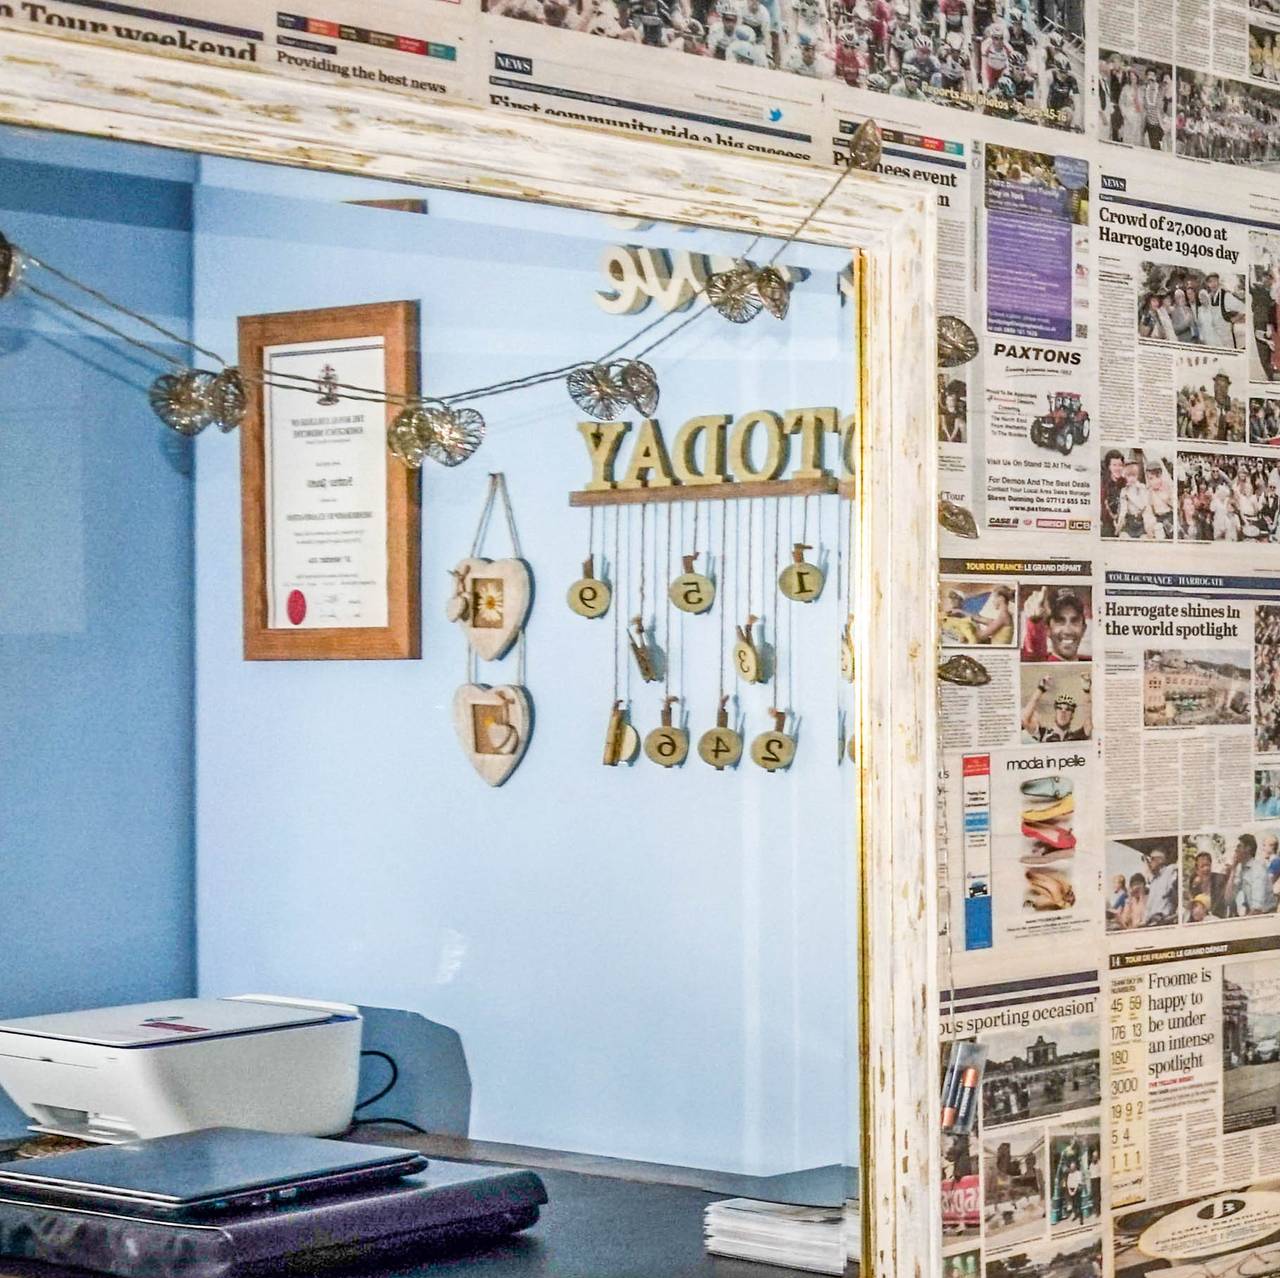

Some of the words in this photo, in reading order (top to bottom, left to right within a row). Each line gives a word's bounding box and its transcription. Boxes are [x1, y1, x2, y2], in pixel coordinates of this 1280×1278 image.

[277, 50, 350, 78] Providing
[352, 66, 375, 81] the
[378, 69, 408, 88] best
[410, 79, 447, 94] news
[496, 56, 531, 72] NEWS
[912, 169, 958, 188] event
[1101, 177, 1126, 190] NEWS
[1099, 207, 1147, 229] Crowd
[1150, 216, 1165, 231] of
[1167, 221, 1212, 239] 27,000
[1214, 227, 1228, 242] at
[1099, 226, 1173, 251] Harrogate
[1175, 241, 1214, 258] 1940s
[1216, 244, 1240, 264] day
[994, 343, 1081, 365] PAXTONS
[1178, 576, 1224, 587] HARROGATE
[1105, 602, 1179, 620] Harrogate
[1181, 602, 1224, 618] shines
[1227, 605, 1240, 619] in
[1105, 621, 1129, 636] the
[1132, 621, 1173, 637] world
[1176, 622, 1238, 639] spotlight
[1007, 757, 1044, 770] moda
[1046, 755, 1056, 768] in
[1058, 754, 1086, 771] pelle
[1149, 973, 1198, 990] Froome
[1201, 967, 1212, 983] is
[1149, 994, 1187, 1013] happy
[1191, 992, 1203, 1005] to
[967, 1008, 1030, 1036] sporting
[1111, 1024, 1126, 1041] 176
[1132, 1023, 1142, 1038] 13
[1149, 1016, 1164, 1033] be
[1168, 1011, 1206, 1030] under
[1148, 1040, 1165, 1054] an
[1169, 1033, 1215, 1051] intense
[1148, 1053, 1203, 1078] spotlight
